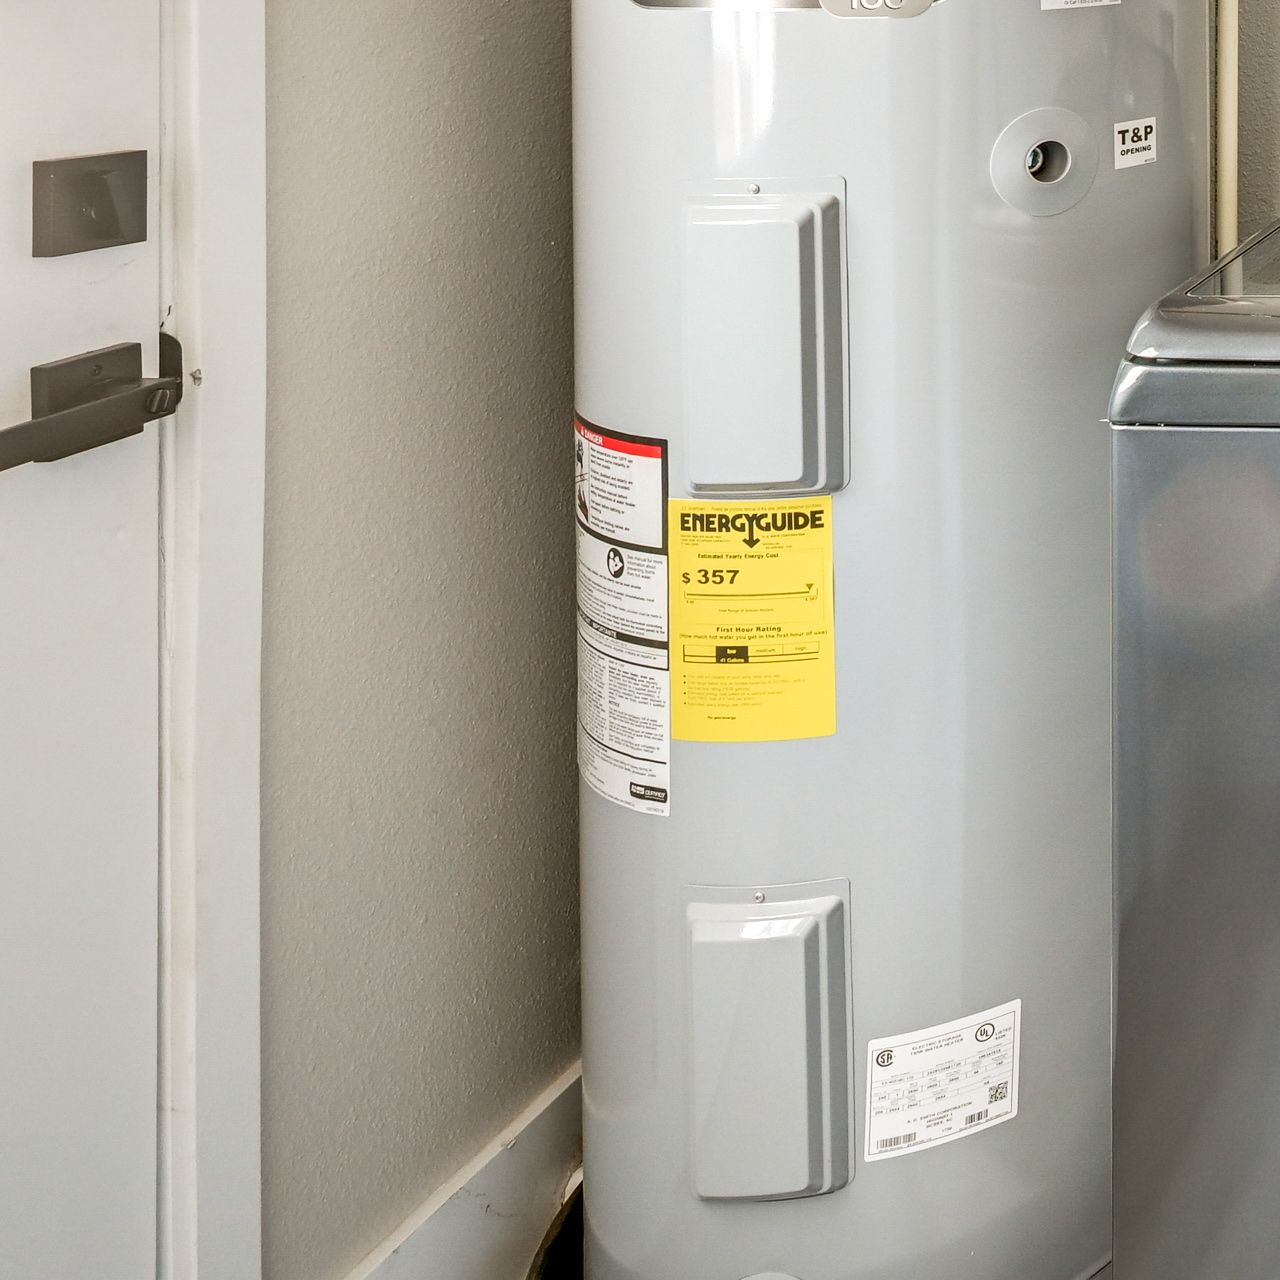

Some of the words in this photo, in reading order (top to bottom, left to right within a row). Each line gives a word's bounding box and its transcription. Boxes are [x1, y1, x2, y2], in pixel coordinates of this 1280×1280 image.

[1118, 125, 1153, 145] T&P
[1120, 145, 1151, 156] OPENING
[585, 429, 603, 445] DANGER
[680, 510, 824, 533] ENERGYGUIDE
[682, 572, 691, 584] $
[697, 569, 740, 584] 357
